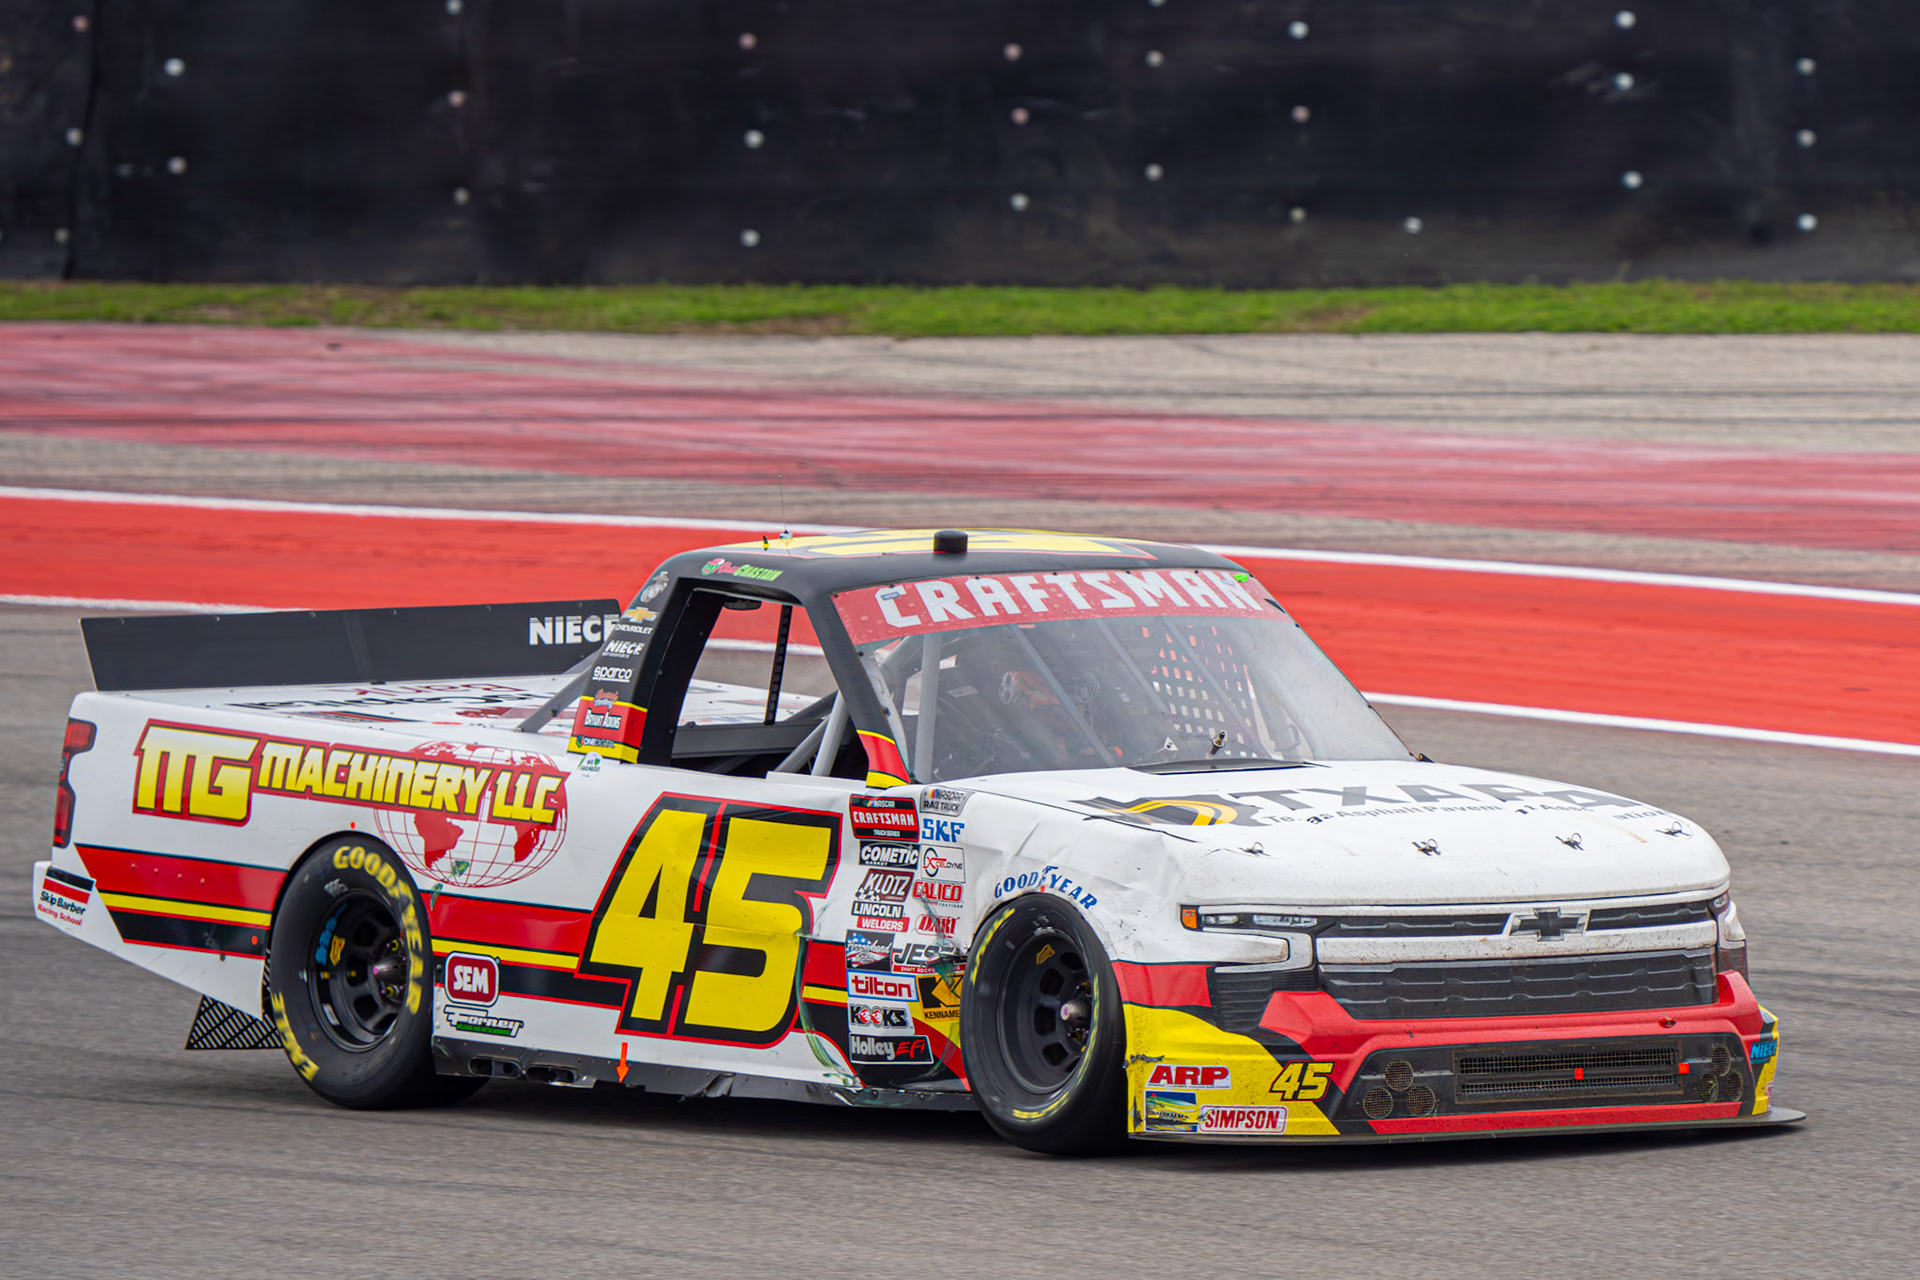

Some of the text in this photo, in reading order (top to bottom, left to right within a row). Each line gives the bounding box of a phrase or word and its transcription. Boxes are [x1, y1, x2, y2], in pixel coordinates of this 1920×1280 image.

[875, 571, 1263, 629] CRAFTSMAN
[614, 623, 653, 635] CHEVROLET
[604, 640, 646, 656] NIECE
[592, 665, 633, 682] sparco
[135, 724, 564, 826] MG MACHINERY LLC
[873, 800, 896, 808] NASCAR
[940, 803, 960, 812] TRUCK
[1226, 784, 1645, 812] TXAPA
[852, 811, 915, 826] CRAFTSMAN
[1262, 813, 1332, 825] Teas
[921, 818, 966, 843] SKF
[861, 846, 919, 865] COMETIC
[863, 872, 911, 896] KLOTZ
[912, 881, 963, 902] CALICO
[994, 866, 1098, 910] GOODYEAR
[37, 902, 83, 926] Racing School
[40, 890, 87, 916] Skip Barber
[853, 902, 903, 919] LINCOLN
[333, 845, 424, 1016] GOODYEAR
[589, 808, 832, 1032] 45
[861, 918, 905, 932] WELDERS
[452, 964, 490, 995] SEM
[851, 975, 912, 998] tilton
[444, 1005, 525, 1038] Forney
[849, 1003, 909, 1028] KOOKS
[923, 1011, 960, 1019] KENNAME
[851, 1035, 926, 1061] Holley EFI
[1749, 1038, 1778, 1060] NIEC
[1149, 1064, 1230, 1086] ARP
[1270, 1061, 1334, 1101] 45
[1203, 1108, 1281, 1130] SIMPSON
